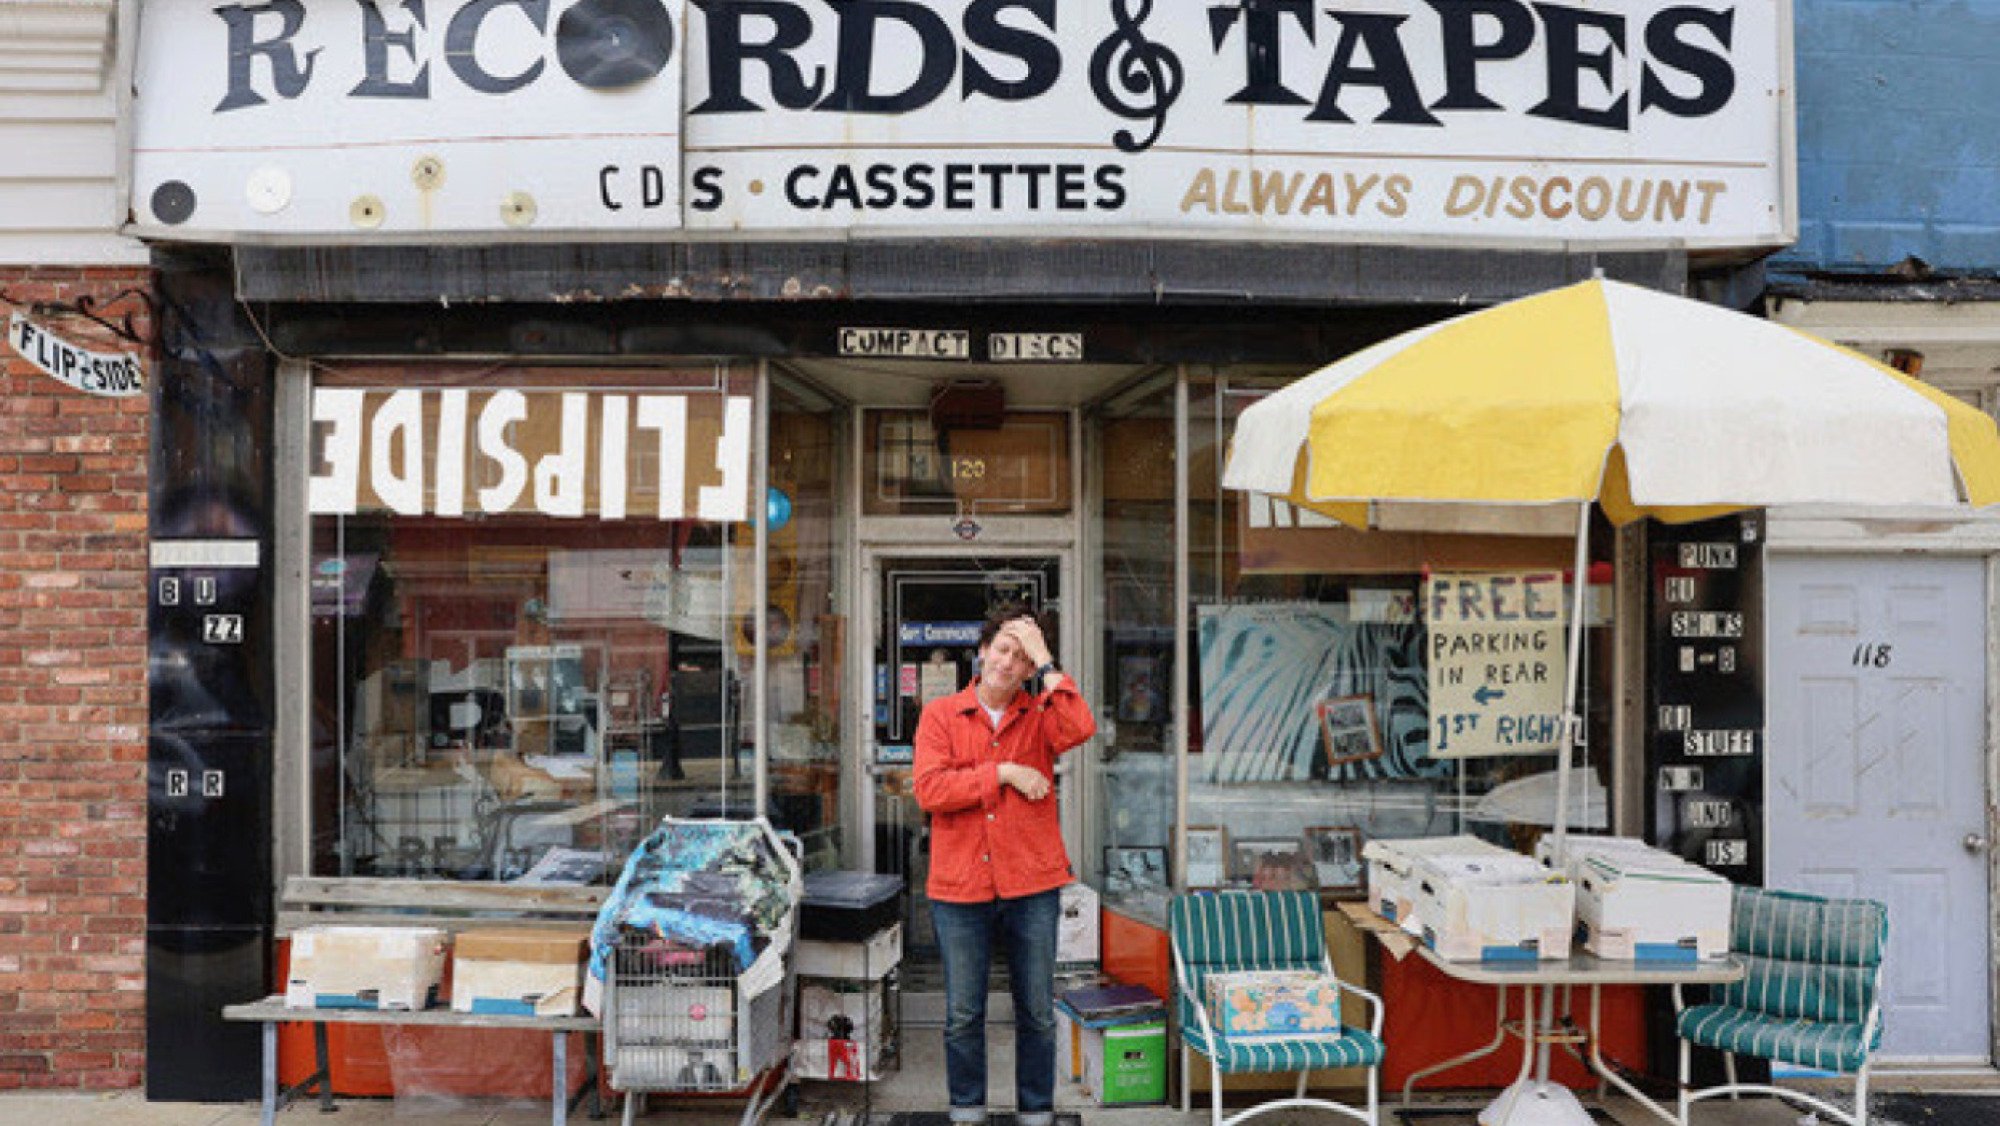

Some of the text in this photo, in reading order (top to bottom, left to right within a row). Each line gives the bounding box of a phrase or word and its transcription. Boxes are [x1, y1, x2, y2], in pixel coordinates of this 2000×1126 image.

[1208, 0, 1736, 131] TAPES
[784, 164, 1127, 210] CASSETTES
[1180, 168, 1412, 217] ALWAYS
[1443, 173, 1728, 224] DISCOUNT
[842, 328, 1082, 359] COMPACT DISCS
[308, 387, 752, 521] FLIPSIDE
[952, 460, 986, 478] 120
[1432, 573, 1557, 622] FREE
[1433, 630, 1548, 660] PARKING
[1853, 642, 1891, 668] 118
[1438, 662, 1548, 687] IN REAR
[1437, 713, 1480, 750] 1ST
[1685, 731, 1752, 755] STUFF
